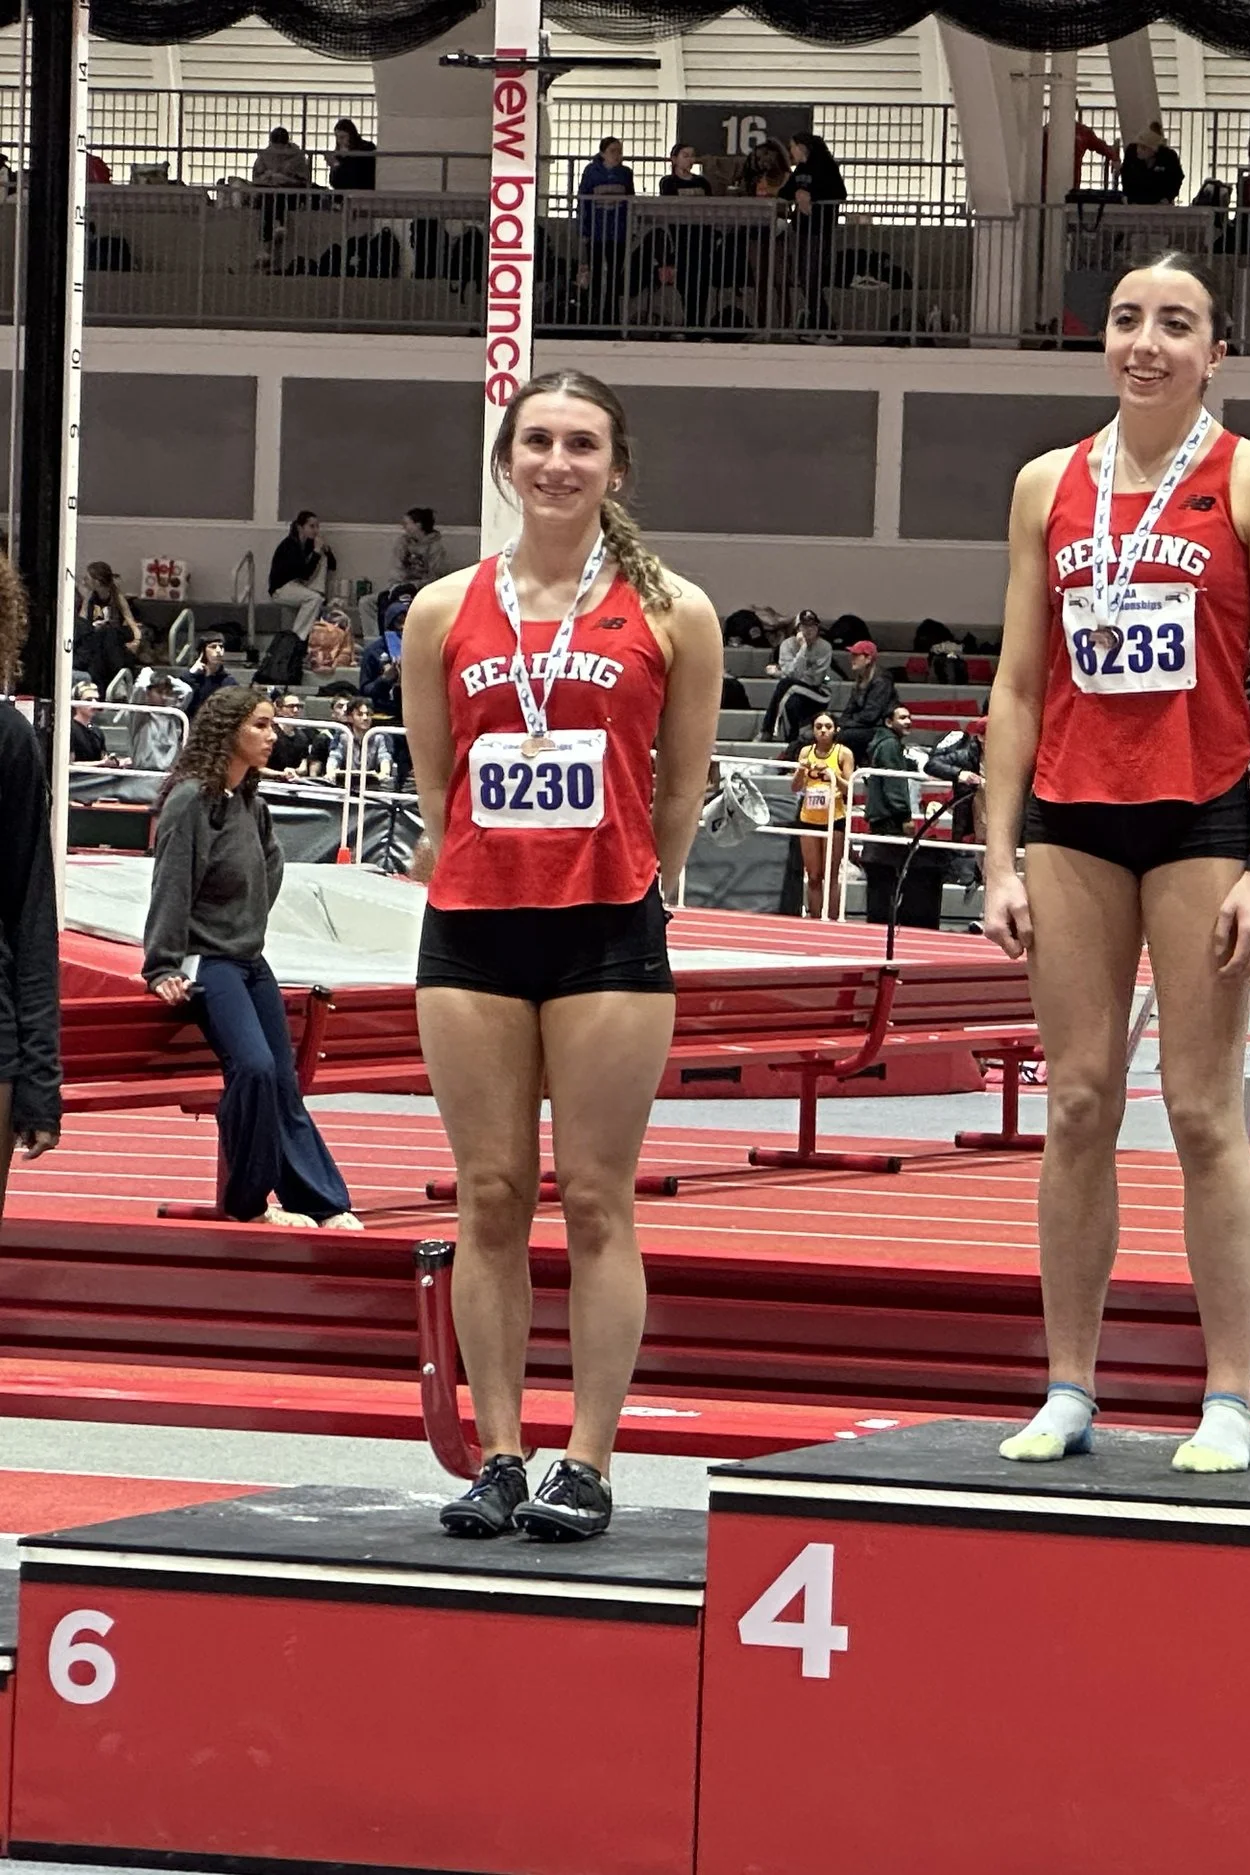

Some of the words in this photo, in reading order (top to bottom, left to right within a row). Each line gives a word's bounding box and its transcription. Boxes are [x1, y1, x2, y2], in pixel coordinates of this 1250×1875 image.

[79, 62, 88, 82] 14
[494, 48, 527, 161] new
[722, 115, 767, 156] 16
[485, 176, 534, 407] balance
[71, 349, 81, 370] 10
[1073, 623, 1186, 675] 8233
[479, 762, 596, 811] 8230
[738, 1542, 849, 1679] 4
[48, 1610, 116, 1704] 6
